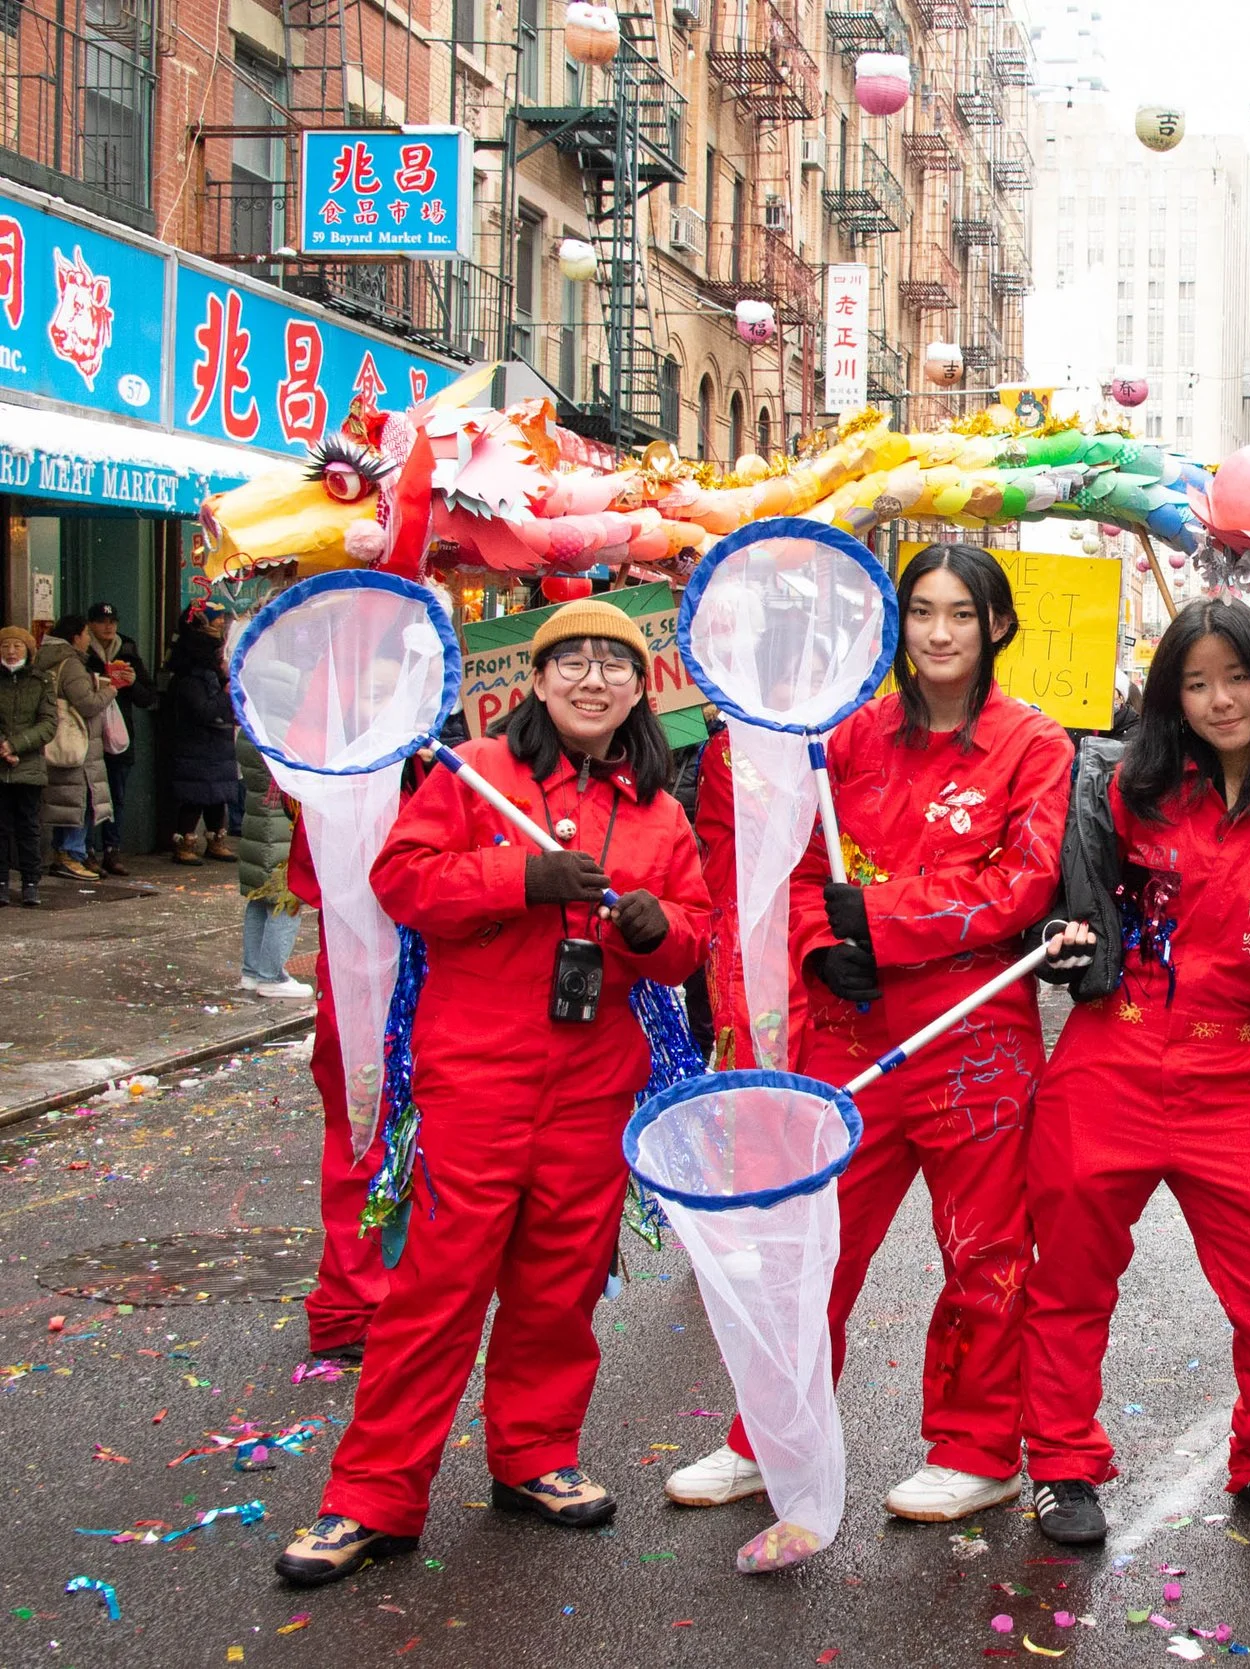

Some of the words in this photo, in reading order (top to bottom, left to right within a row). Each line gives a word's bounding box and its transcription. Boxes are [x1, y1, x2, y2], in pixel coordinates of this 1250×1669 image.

[1156, 111, 1180, 136] 吉
[329, 141, 437, 195] 兆昌
[319, 199, 447, 225] 食品市場
[312, 231, 326, 244] 59
[330, 231, 373, 247] Bayard
[379, 231, 422, 244] Market
[428, 232, 452, 244] Inc.
[834, 295, 857, 379] 老正川
[127, 379, 143, 401] 57
[39, 454, 96, 496] MEAT
[102, 463, 179, 506] MARKET
[1000, 557, 1039, 586] ME
[465, 655, 511, 678] FROM
[517, 650, 531, 665] TH
[660, 617, 676, 634] SE
